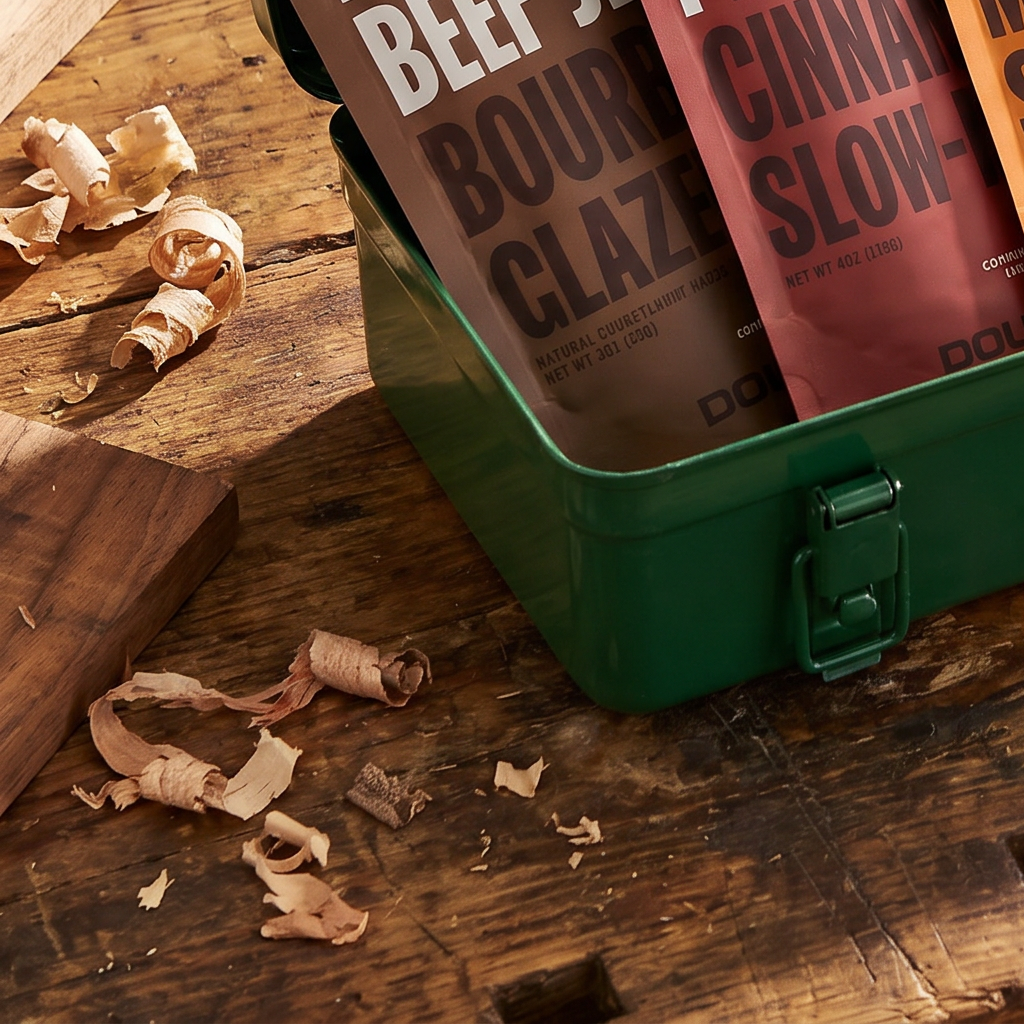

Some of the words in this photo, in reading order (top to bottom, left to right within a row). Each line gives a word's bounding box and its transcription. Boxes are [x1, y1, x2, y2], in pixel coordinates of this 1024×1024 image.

[785, 269, 810, 289] NET
[813, 261, 833, 279] WT
[535, 333, 596, 371] NATURAL
[544, 363, 570, 386] NET
[572, 353, 594, 373] WT
